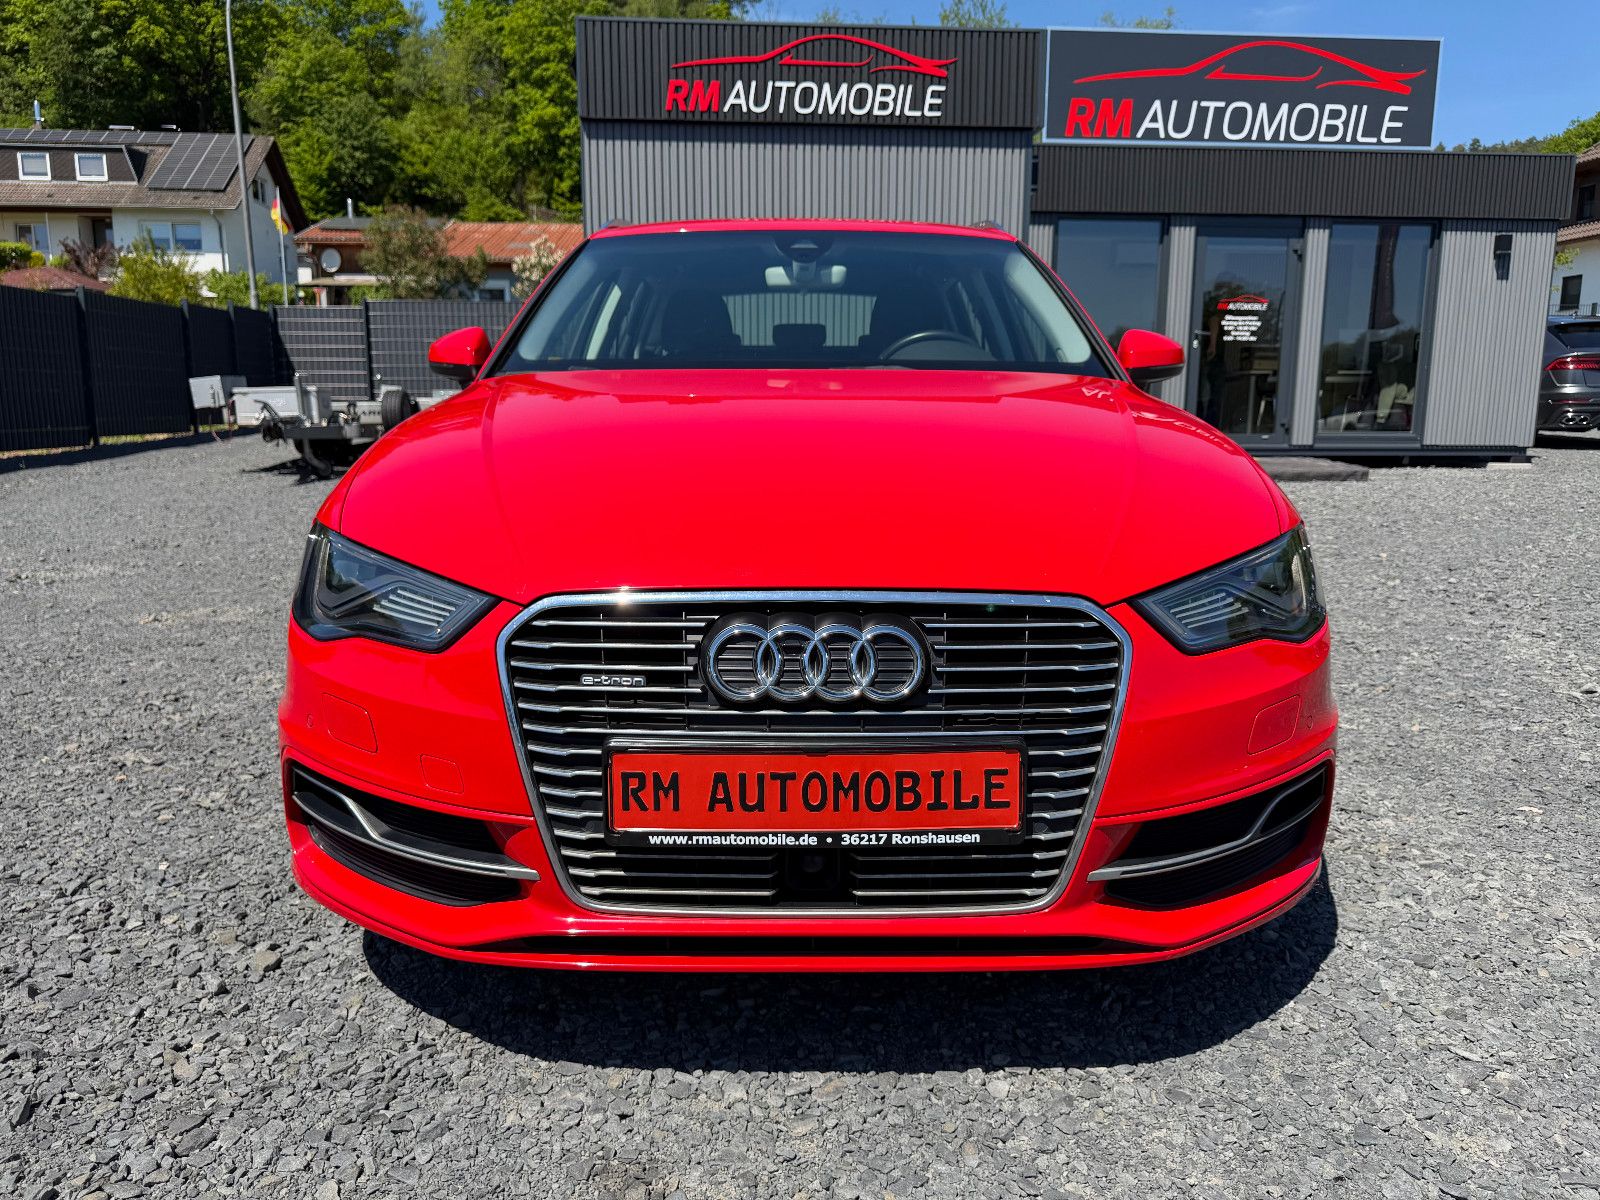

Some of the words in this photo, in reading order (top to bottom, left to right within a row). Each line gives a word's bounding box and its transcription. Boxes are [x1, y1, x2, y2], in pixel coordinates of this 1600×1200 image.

[665, 79, 721, 113] RM
[722, 80, 947, 117] AUTOMOBILE
[1064, 97, 1134, 138] RM
[1136, 99, 1409, 144] AUTOMOBILE
[581, 675, 644, 686] e-tron
[620, 771, 680, 812] RM
[707, 768, 1011, 813] AUTOMOBILE
[648, 833, 818, 846] www.rmautomobile.de
[840, 833, 888, 846] 36217
[891, 832, 981, 845] Ronshausen
